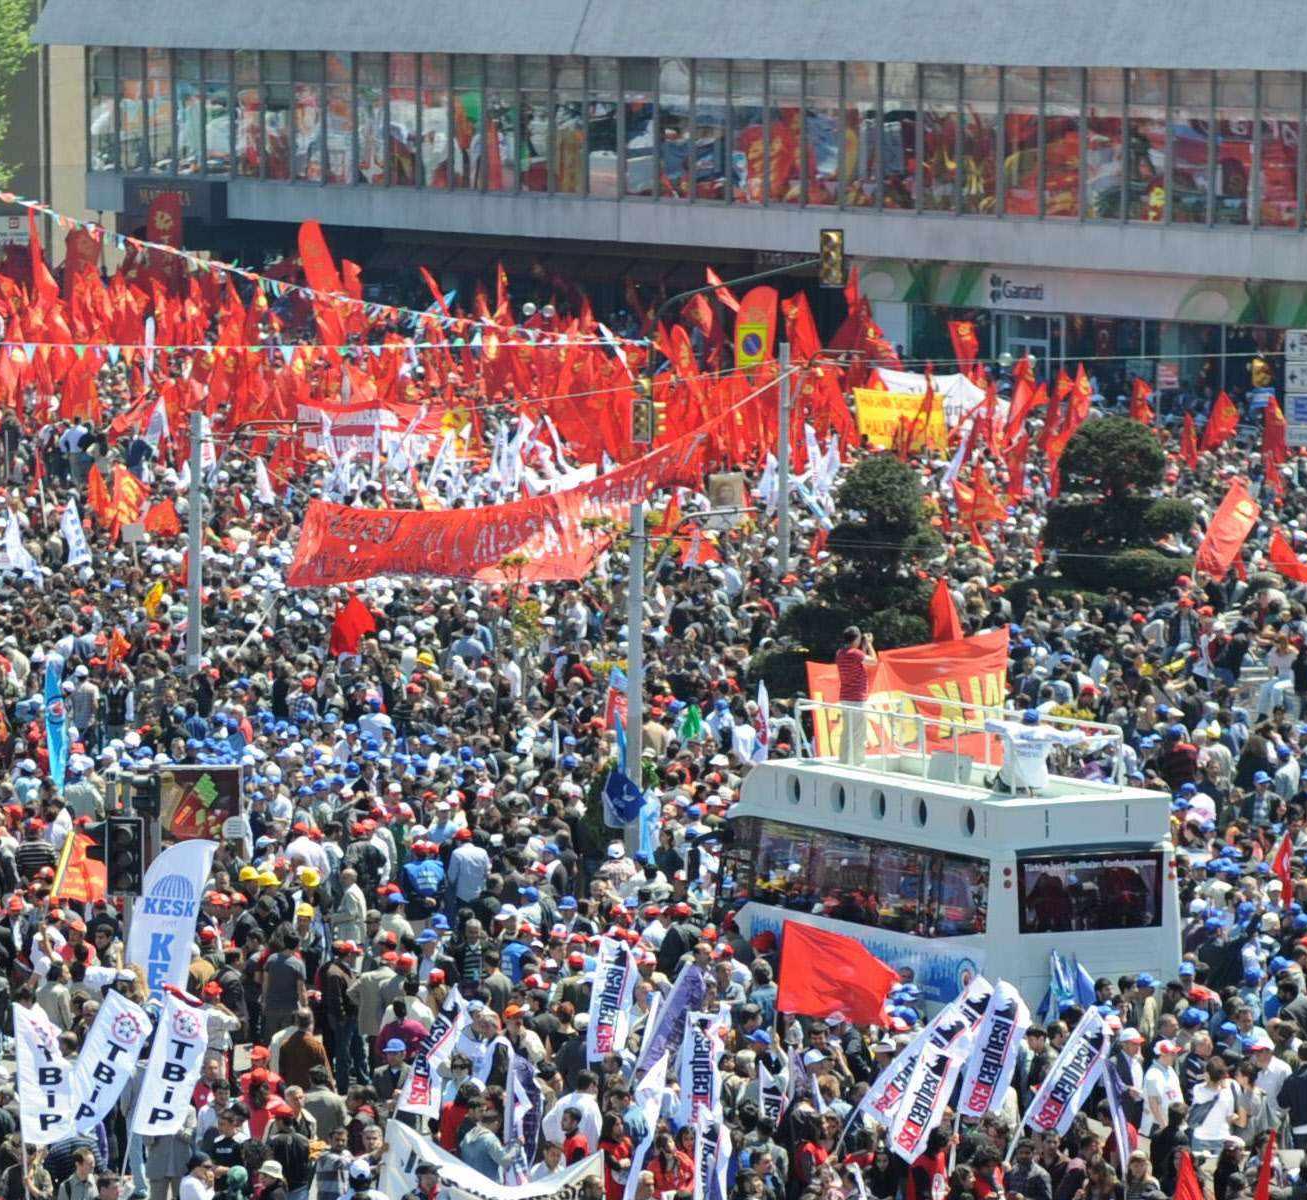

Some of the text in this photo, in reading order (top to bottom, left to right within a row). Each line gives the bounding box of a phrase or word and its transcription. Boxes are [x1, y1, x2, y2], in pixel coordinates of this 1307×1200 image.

[1003, 280, 1044, 300] Garanti
[143, 897, 196, 918] KESK
[977, 1017, 1013, 1085] cephesi
[1050, 1045, 1096, 1105] cephesi
[907, 1064, 939, 1127] cephesi
